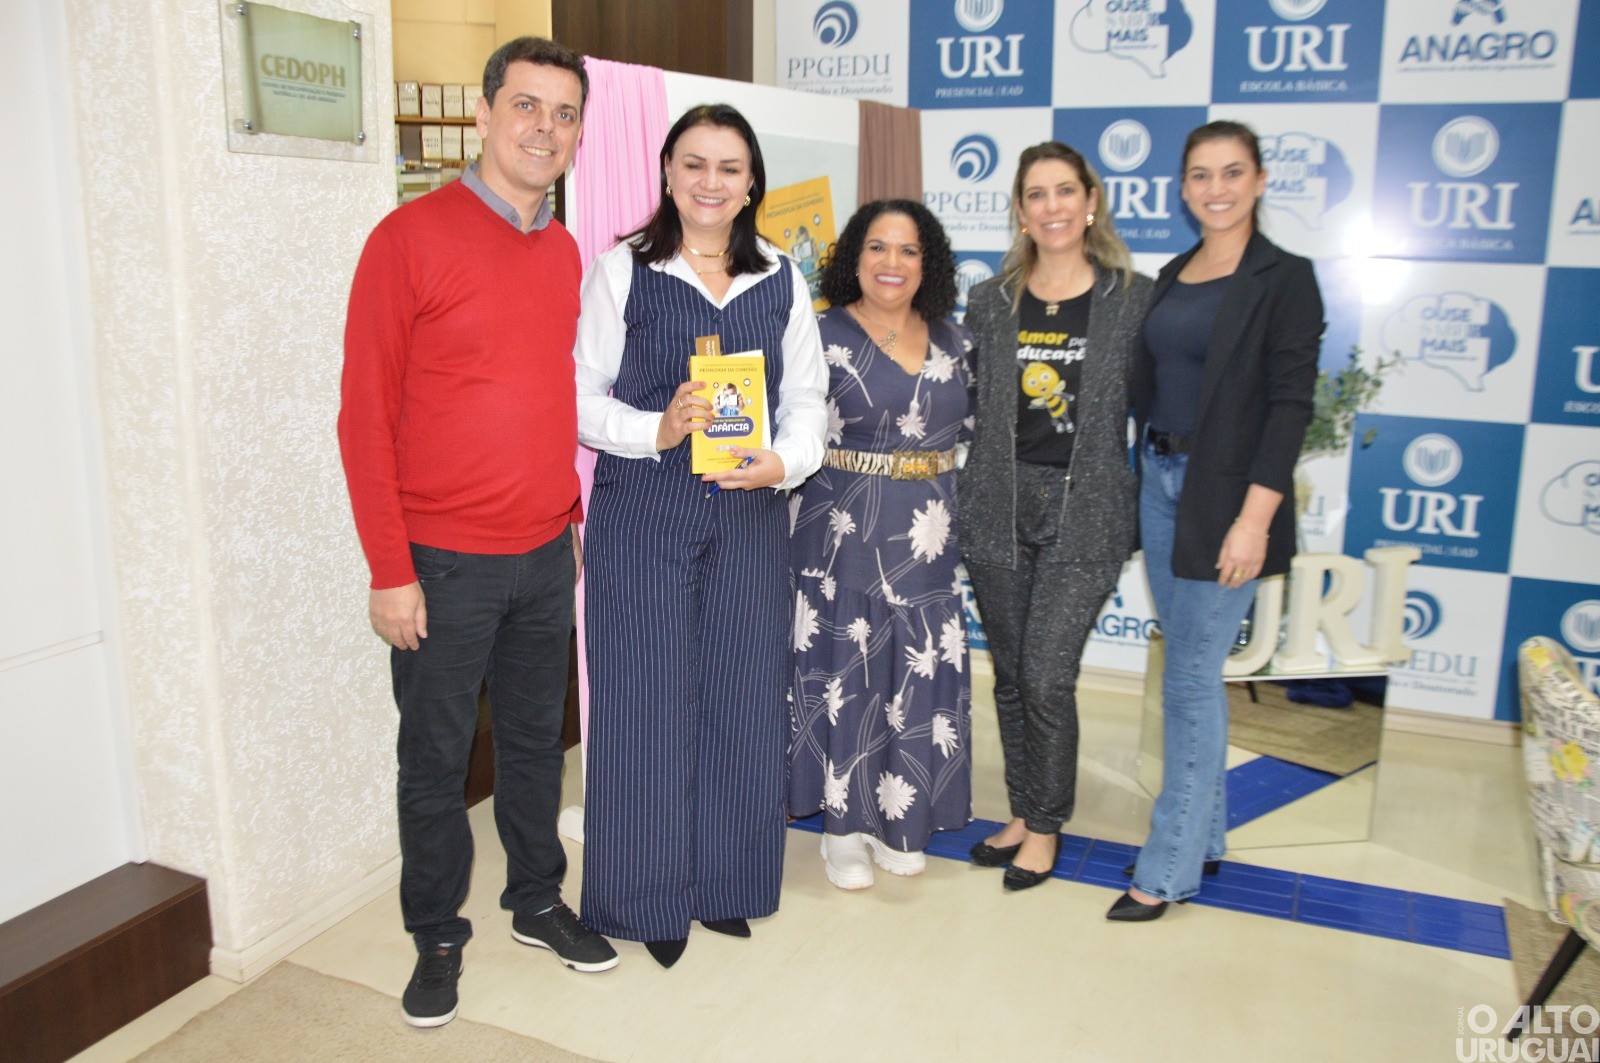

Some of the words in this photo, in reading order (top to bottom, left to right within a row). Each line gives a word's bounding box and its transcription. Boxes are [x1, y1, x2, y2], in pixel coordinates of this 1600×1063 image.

[1107, 29, 1149, 42] MAIS
[1244, 24, 1351, 72] URI
[1399, 30, 1557, 63] ANAGRO
[261, 53, 346, 88] CEDOPH
[787, 53, 891, 79] PPGEDU
[936, 34, 1025, 79] URI
[1407, 182, 1519, 230] URI
[1421, 339, 1469, 352] MAIS
[1379, 487, 1484, 538] URI
